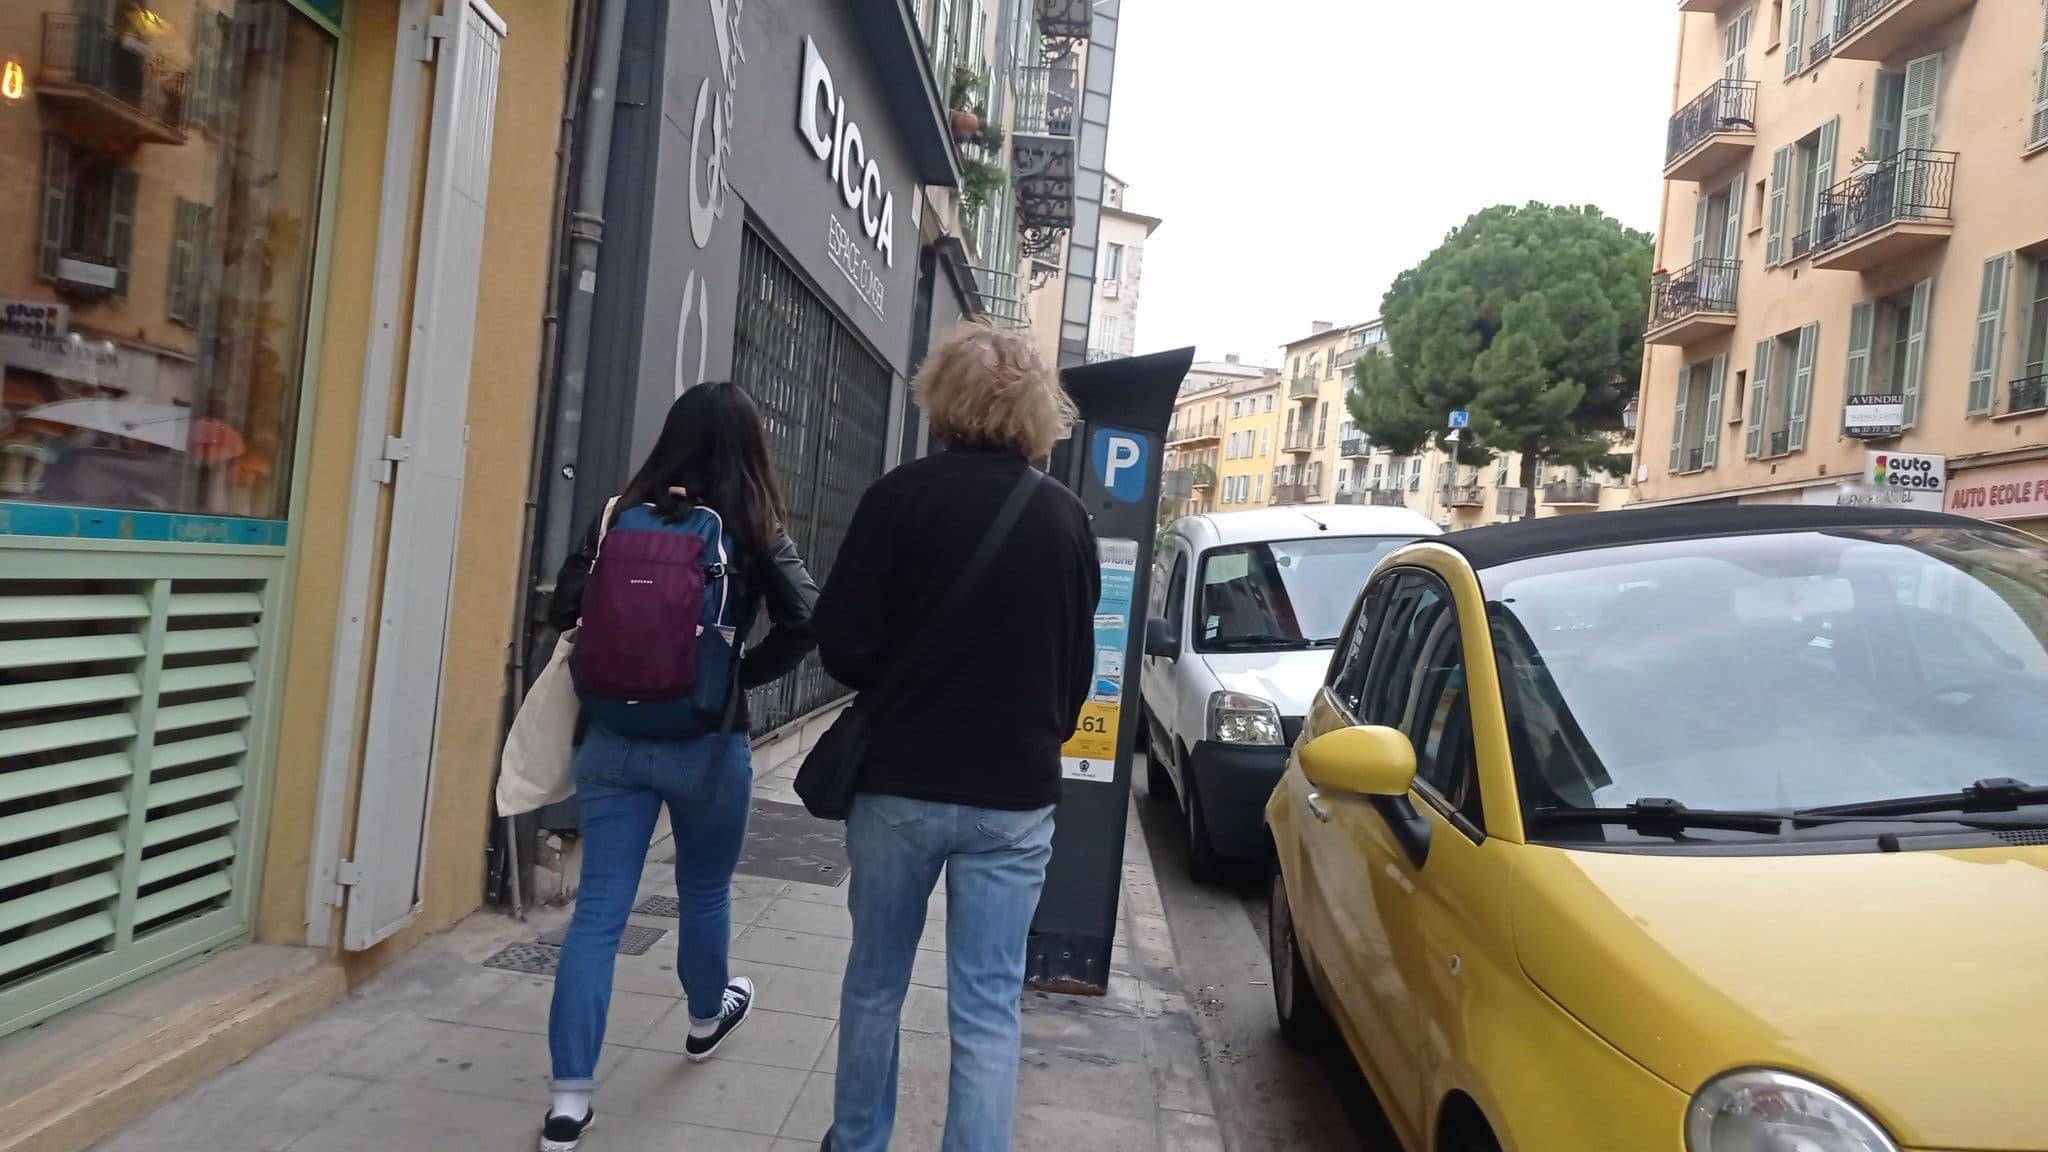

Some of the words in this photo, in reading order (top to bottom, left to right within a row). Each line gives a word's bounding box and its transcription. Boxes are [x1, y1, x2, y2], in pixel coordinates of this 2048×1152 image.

[804, 45, 894, 269] CICCA
[828, 213, 861, 281] ESPACE
[1851, 396, 1859, 404] A
[1104, 436, 1140, 488] P
[1889, 457, 1931, 471] auto
[1889, 472, 1939, 487] école
[1951, 486, 1986, 509] AUTO
[1990, 481, 2032, 506] ECOLE
